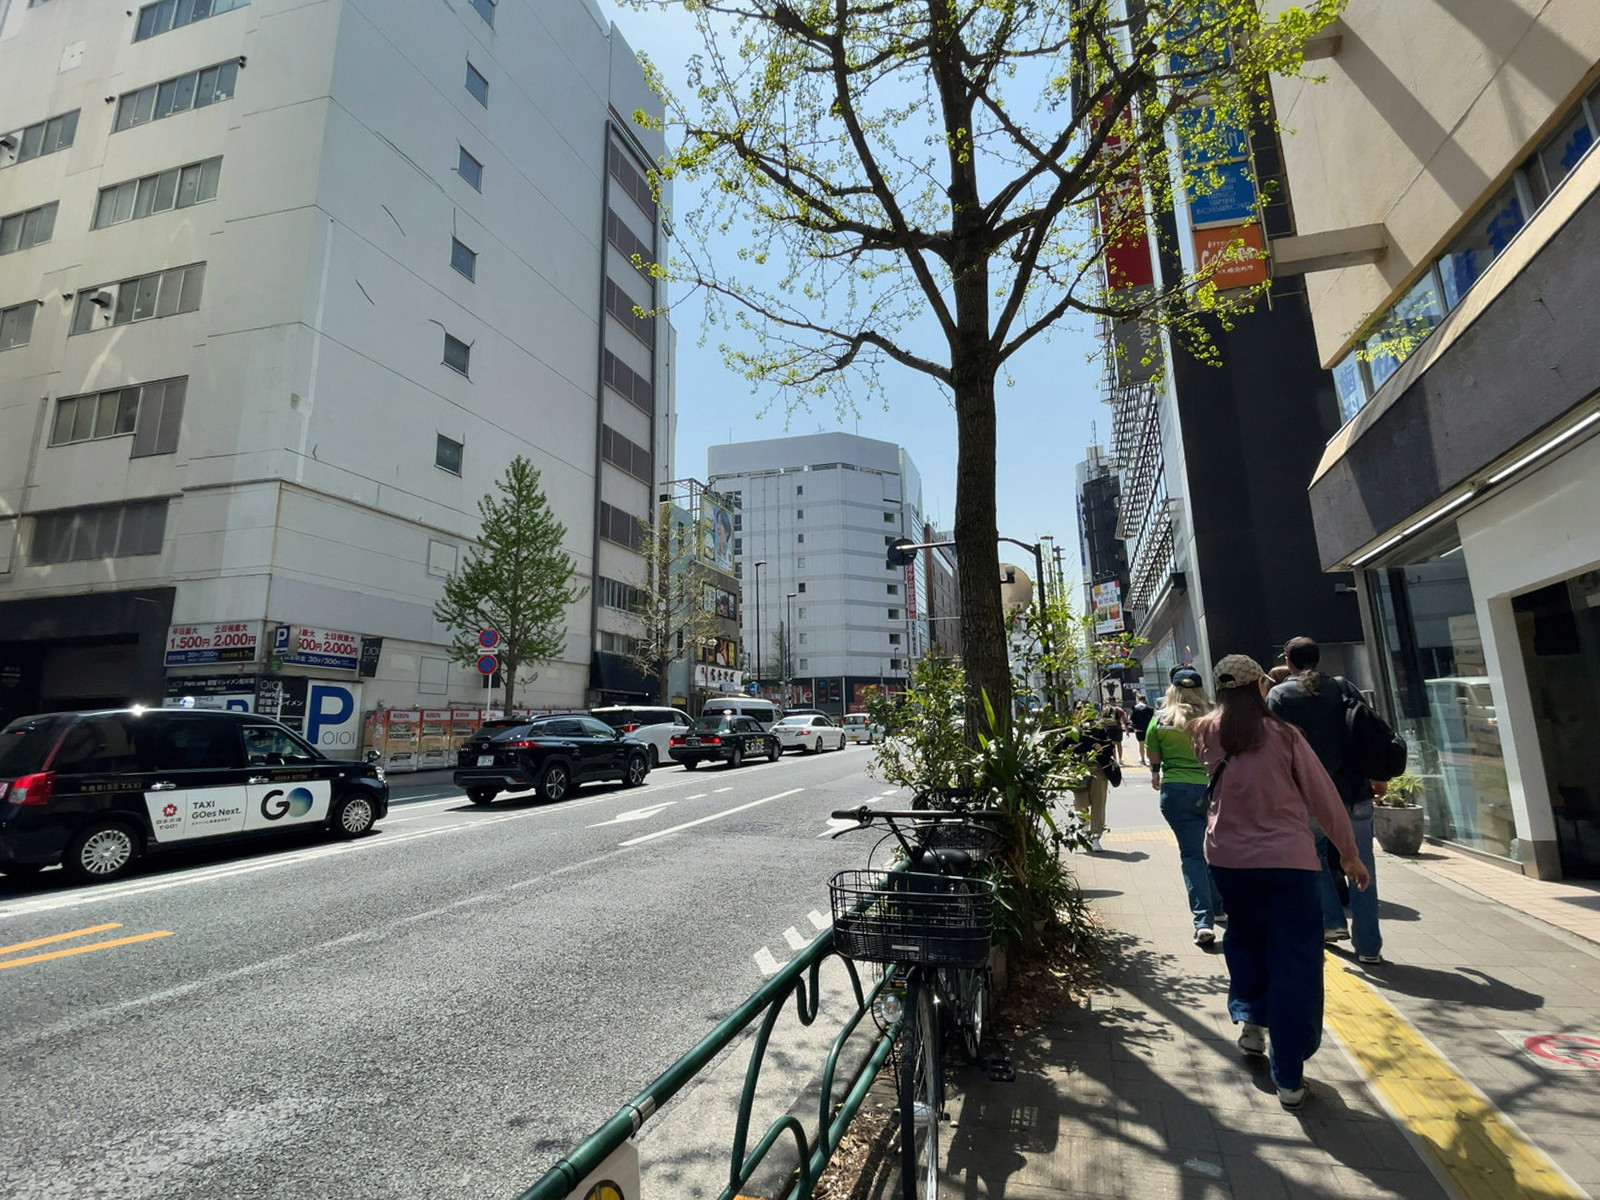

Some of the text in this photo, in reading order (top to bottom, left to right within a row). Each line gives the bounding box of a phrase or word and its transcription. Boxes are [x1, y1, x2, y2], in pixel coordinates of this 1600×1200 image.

[214, 633, 257, 647] 2,000円
[276, 628, 288, 647] P
[323, 641, 358, 656] 2,000円
[307, 685, 354, 745] P
[193, 800, 215, 809] TAXI
[260, 787, 314, 821] GO
[191, 807, 242, 820] GOes Next.
